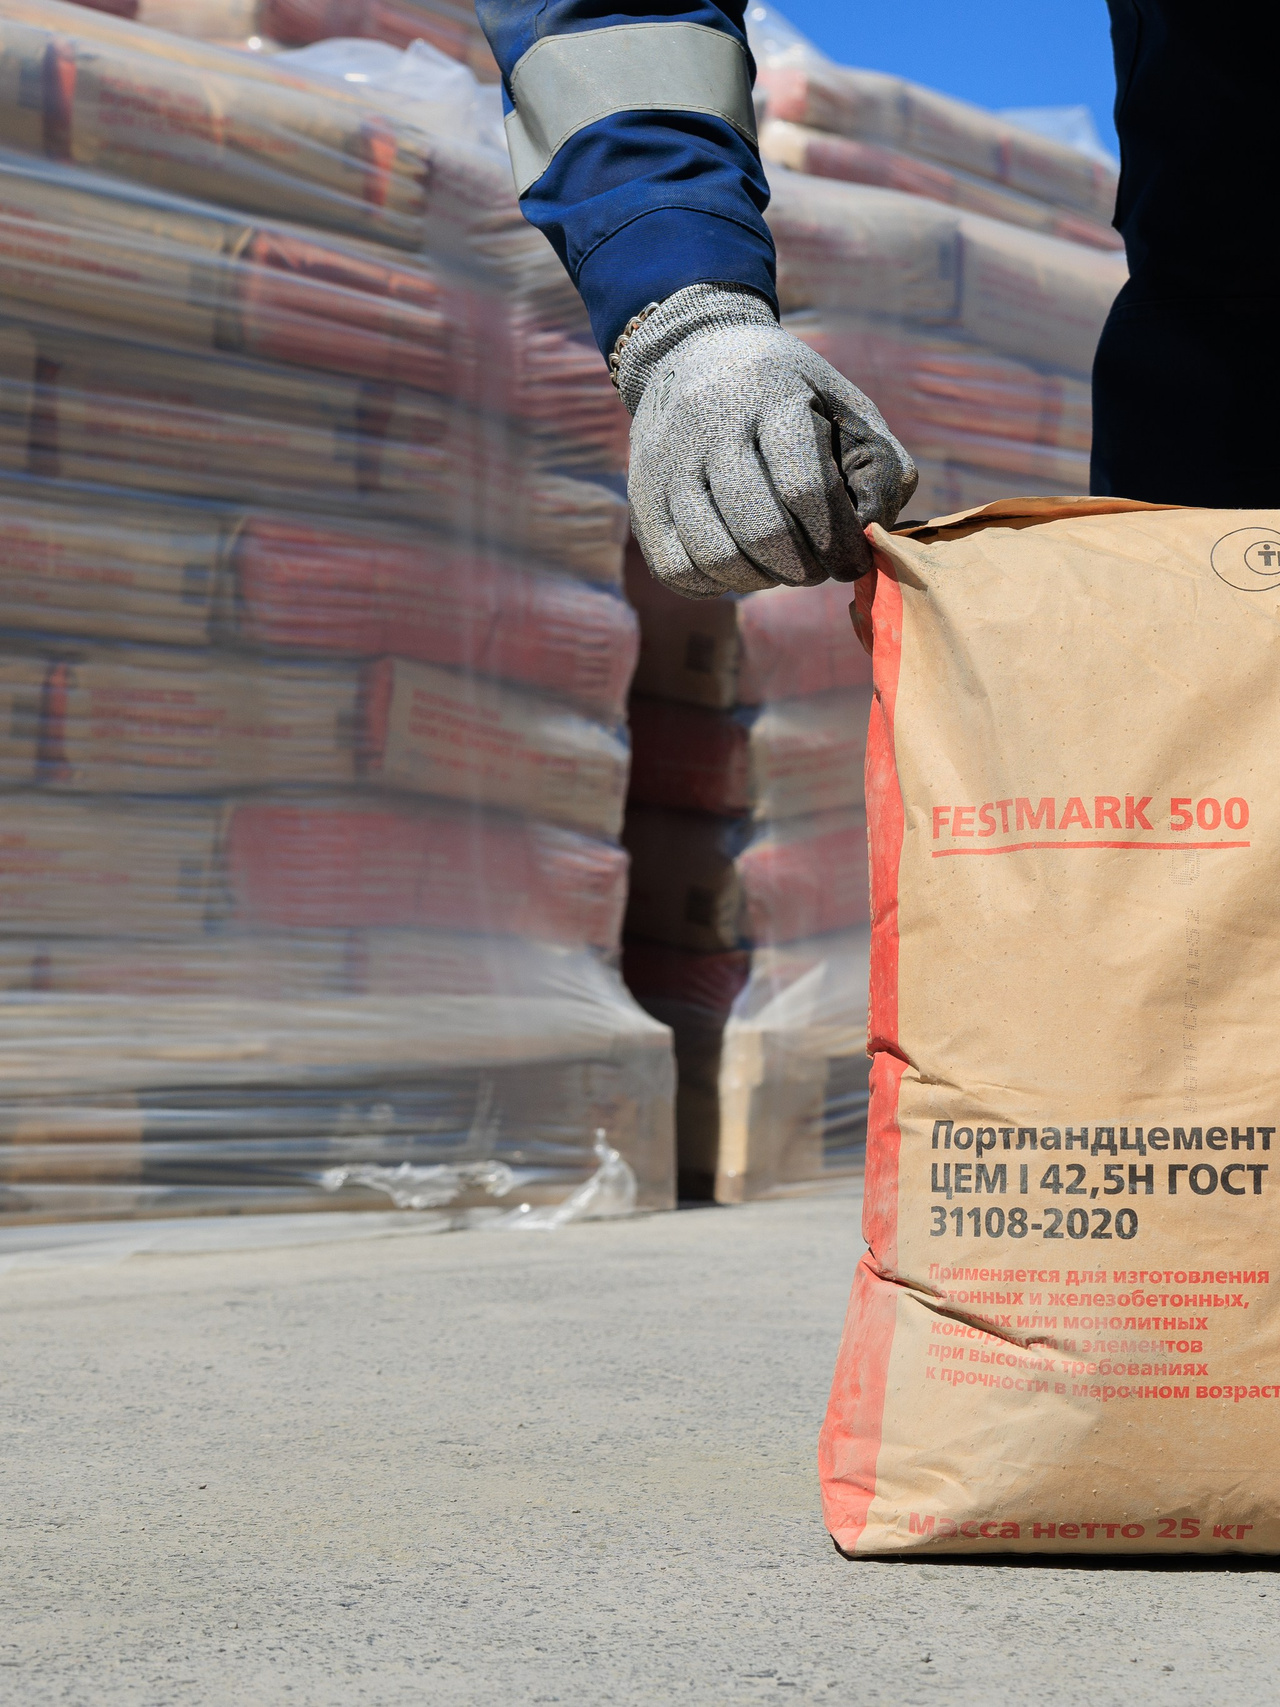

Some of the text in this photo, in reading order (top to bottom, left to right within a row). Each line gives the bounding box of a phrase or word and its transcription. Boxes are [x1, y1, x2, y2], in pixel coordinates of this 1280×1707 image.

[931, 795, 1251, 840] FESTMARK 500
[930, 1120, 1276, 1158] Портландцемент
[930, 1163, 1008, 1200] ЦЕМ
[1039, 1162, 1154, 1200] 42,5Н
[1167, 1162, 1269, 1196] ГОСТ
[929, 1205, 1139, 1240] 31108-2020
[928, 1263, 1269, 1287] Применяется для изготовления
[1029, 1293, 1043, 1305] и
[1047, 1289, 1250, 1310] железобетонных,
[1017, 1315, 1058, 1329] или
[1063, 1315, 1208, 1331] монолитных
[927, 1343, 1209, 1381] при высоких требованиях
[1063, 1339, 1076, 1351] и
[1082, 1339, 1203, 1354] элементов
[925, 1366, 937, 1379] к
[940, 1368, 1050, 1394] прочности
[1054, 1381, 1066, 1394] в
[1071, 1382, 1190, 1403] марочном
[908, 1511, 1254, 1541] Масса нетто 25 кг
